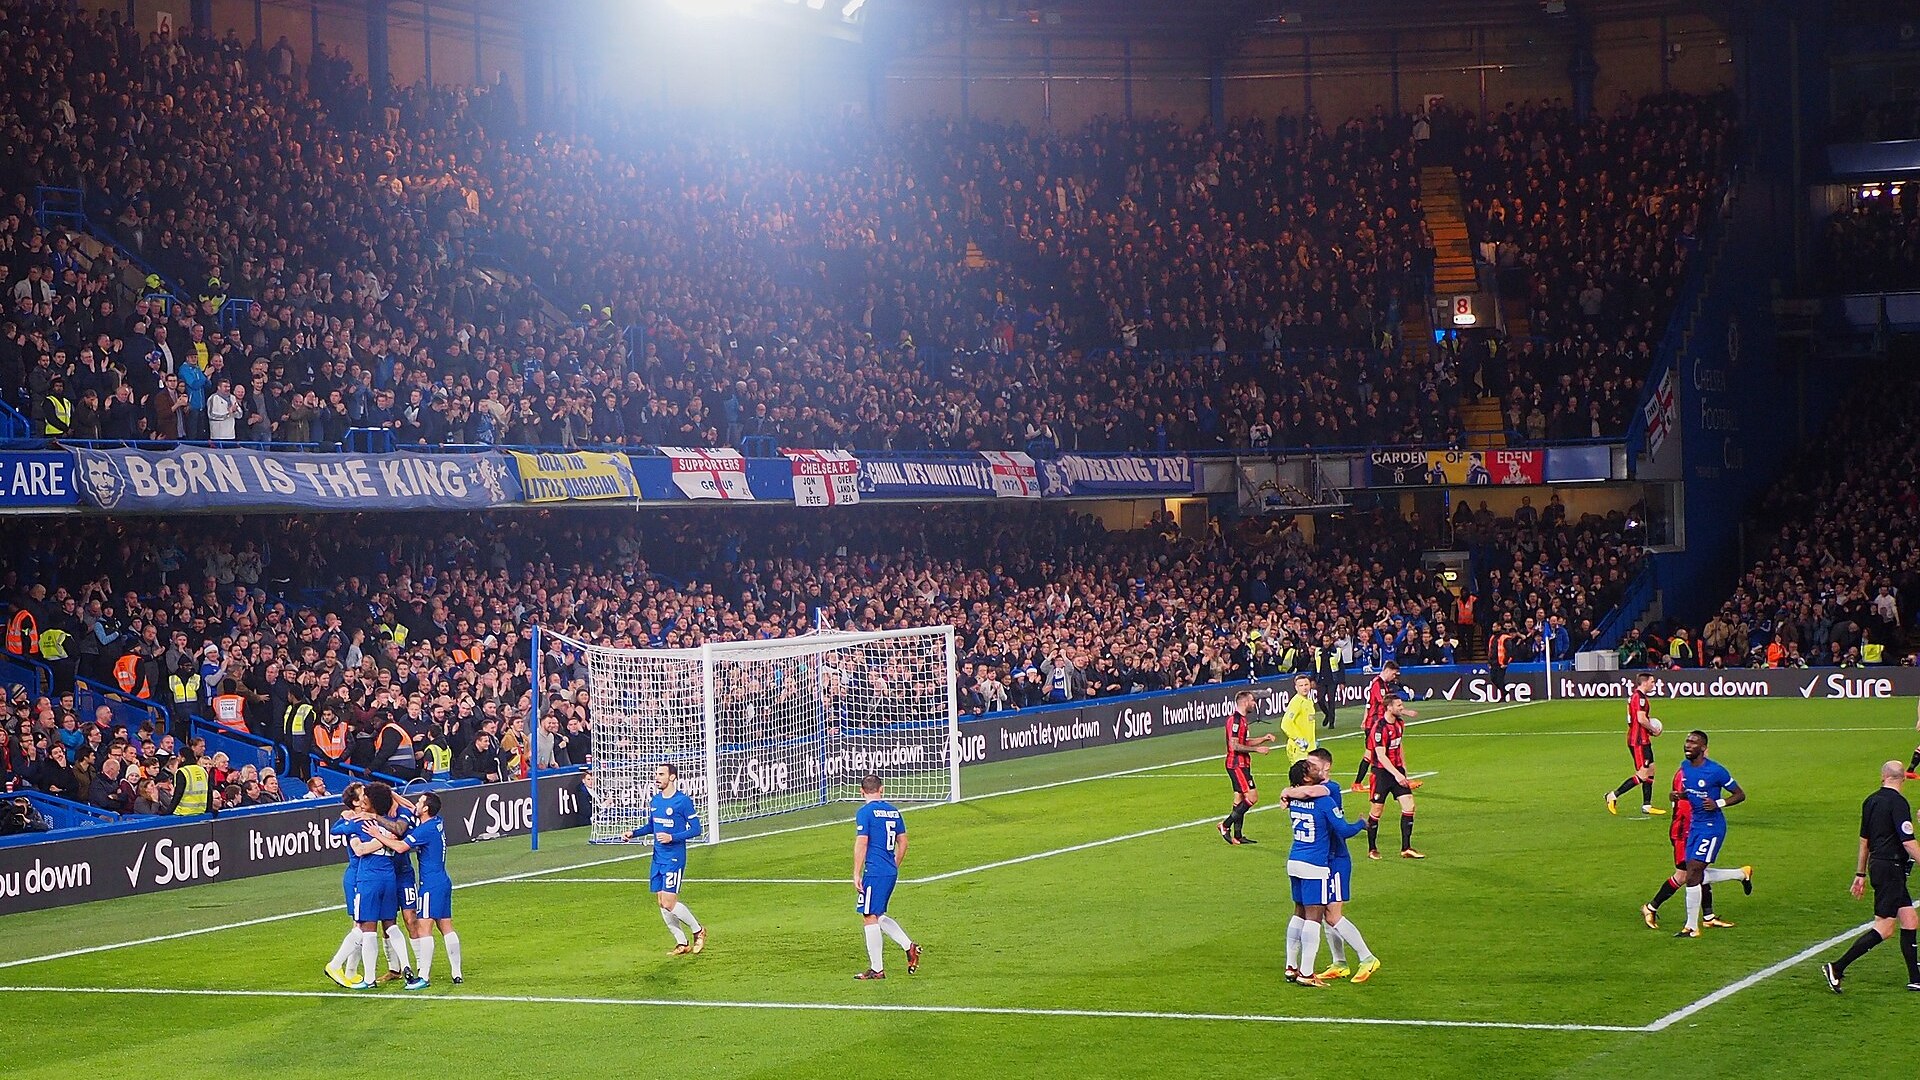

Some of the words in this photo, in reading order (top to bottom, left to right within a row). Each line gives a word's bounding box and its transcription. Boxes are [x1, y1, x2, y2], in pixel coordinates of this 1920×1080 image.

[1457, 298, 1468, 314] 8
[679, 458, 740, 471] SUPPORTERS
[800, 462, 838, 475] CHELSEA
[838, 461, 850, 473] FC
[1150, 457, 1191, 482] 202
[1371, 452, 1428, 465] GARDEN
[1446, 452, 1464, 463] OF
[1497, 451, 1533, 464] EDEN
[12, 461, 66, 496] ARE
[124, 452, 248, 497] BORN
[248, 456, 296, 494] IS
[295, 459, 380, 498] THE
[378, 458, 468, 498] KING
[561, 474, 620, 499] MAGICIAN
[700, 480, 734, 491] GRUP
[803, 477, 816, 486] JON
[837, 475, 853, 484] OVER
[1341, 686, 1362, 705] you
[1469, 679, 1531, 703] Sure
[1561, 678, 1575, 697] It
[1579, 677, 1634, 698] won't
[1647, 679, 1665, 697] et
[1667, 681, 1705, 698] you
[1709, 676, 1769, 696] down
[1826, 673, 1892, 699] Sure
[1124, 708, 1152, 739] Sure
[1162, 705, 1170, 726] It
[1169, 701, 1194, 725] won't
[1194, 700, 1205, 721] let
[1205, 702, 1221, 724] you
[1000, 727, 1009, 750] It
[1009, 723, 1038, 749] won't
[1038, 721, 1052, 745] let
[1052, 725, 1071, 748] you
[1071, 717, 1100, 740] down
[805, 753, 815, 778] It
[851, 746, 868, 771] let
[868, 750, 890, 775] you
[890, 741, 924, 765] down
[747, 759, 788, 793] Sure
[485, 793, 532, 834] Sure
[558, 787, 571, 815] It
[886, 820, 896, 851] 6
[1290, 811, 1315, 843] 23
[249, 829, 263, 861] It
[265, 821, 321, 856] won't
[1698, 839, 1710, 852] 2
[155, 838, 220, 886] Sure
[25, 858, 91, 895] down
[666, 872, 677, 886] 21
[404, 887, 416, 901] 16
